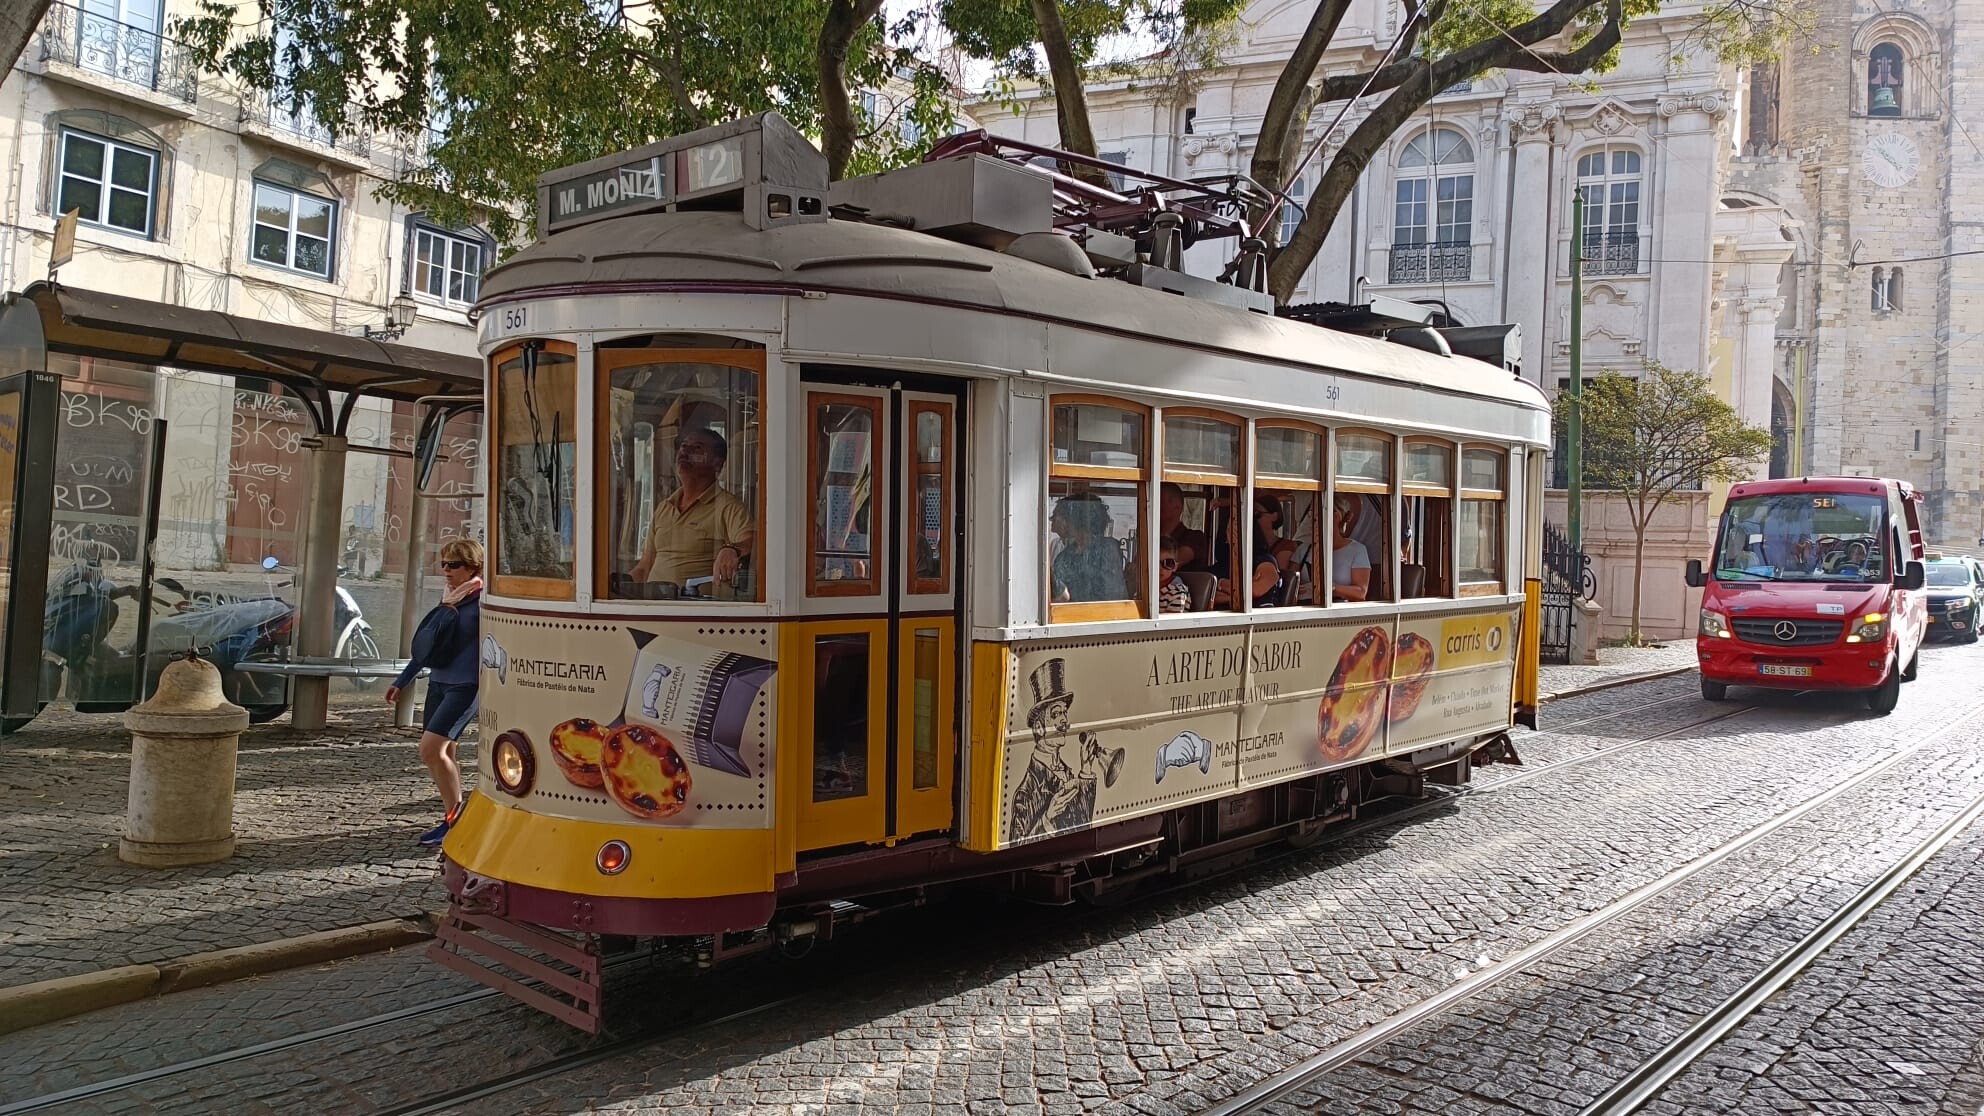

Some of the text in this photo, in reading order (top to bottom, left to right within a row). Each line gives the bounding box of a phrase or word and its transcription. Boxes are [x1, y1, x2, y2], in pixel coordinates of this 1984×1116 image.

[694, 143, 729, 188] 12
[560, 167, 658, 216] M. MONIZ
[506, 307, 526, 330] 561
[1326, 385, 1340, 401] 561
[1446, 626, 1481, 654] carris
[510, 657, 607, 681] MANTEIGARIA
[1146, 640, 1302, 687] A ARTE DO SABOR
[536, 681, 544, 689] de
[568, 684, 577, 692] de
[578, 685, 595, 694] Nata
[1170, 682, 1280, 715] THE ART OF FLAVOUR
[1215, 732, 1284, 758] MANTEIGARIA
